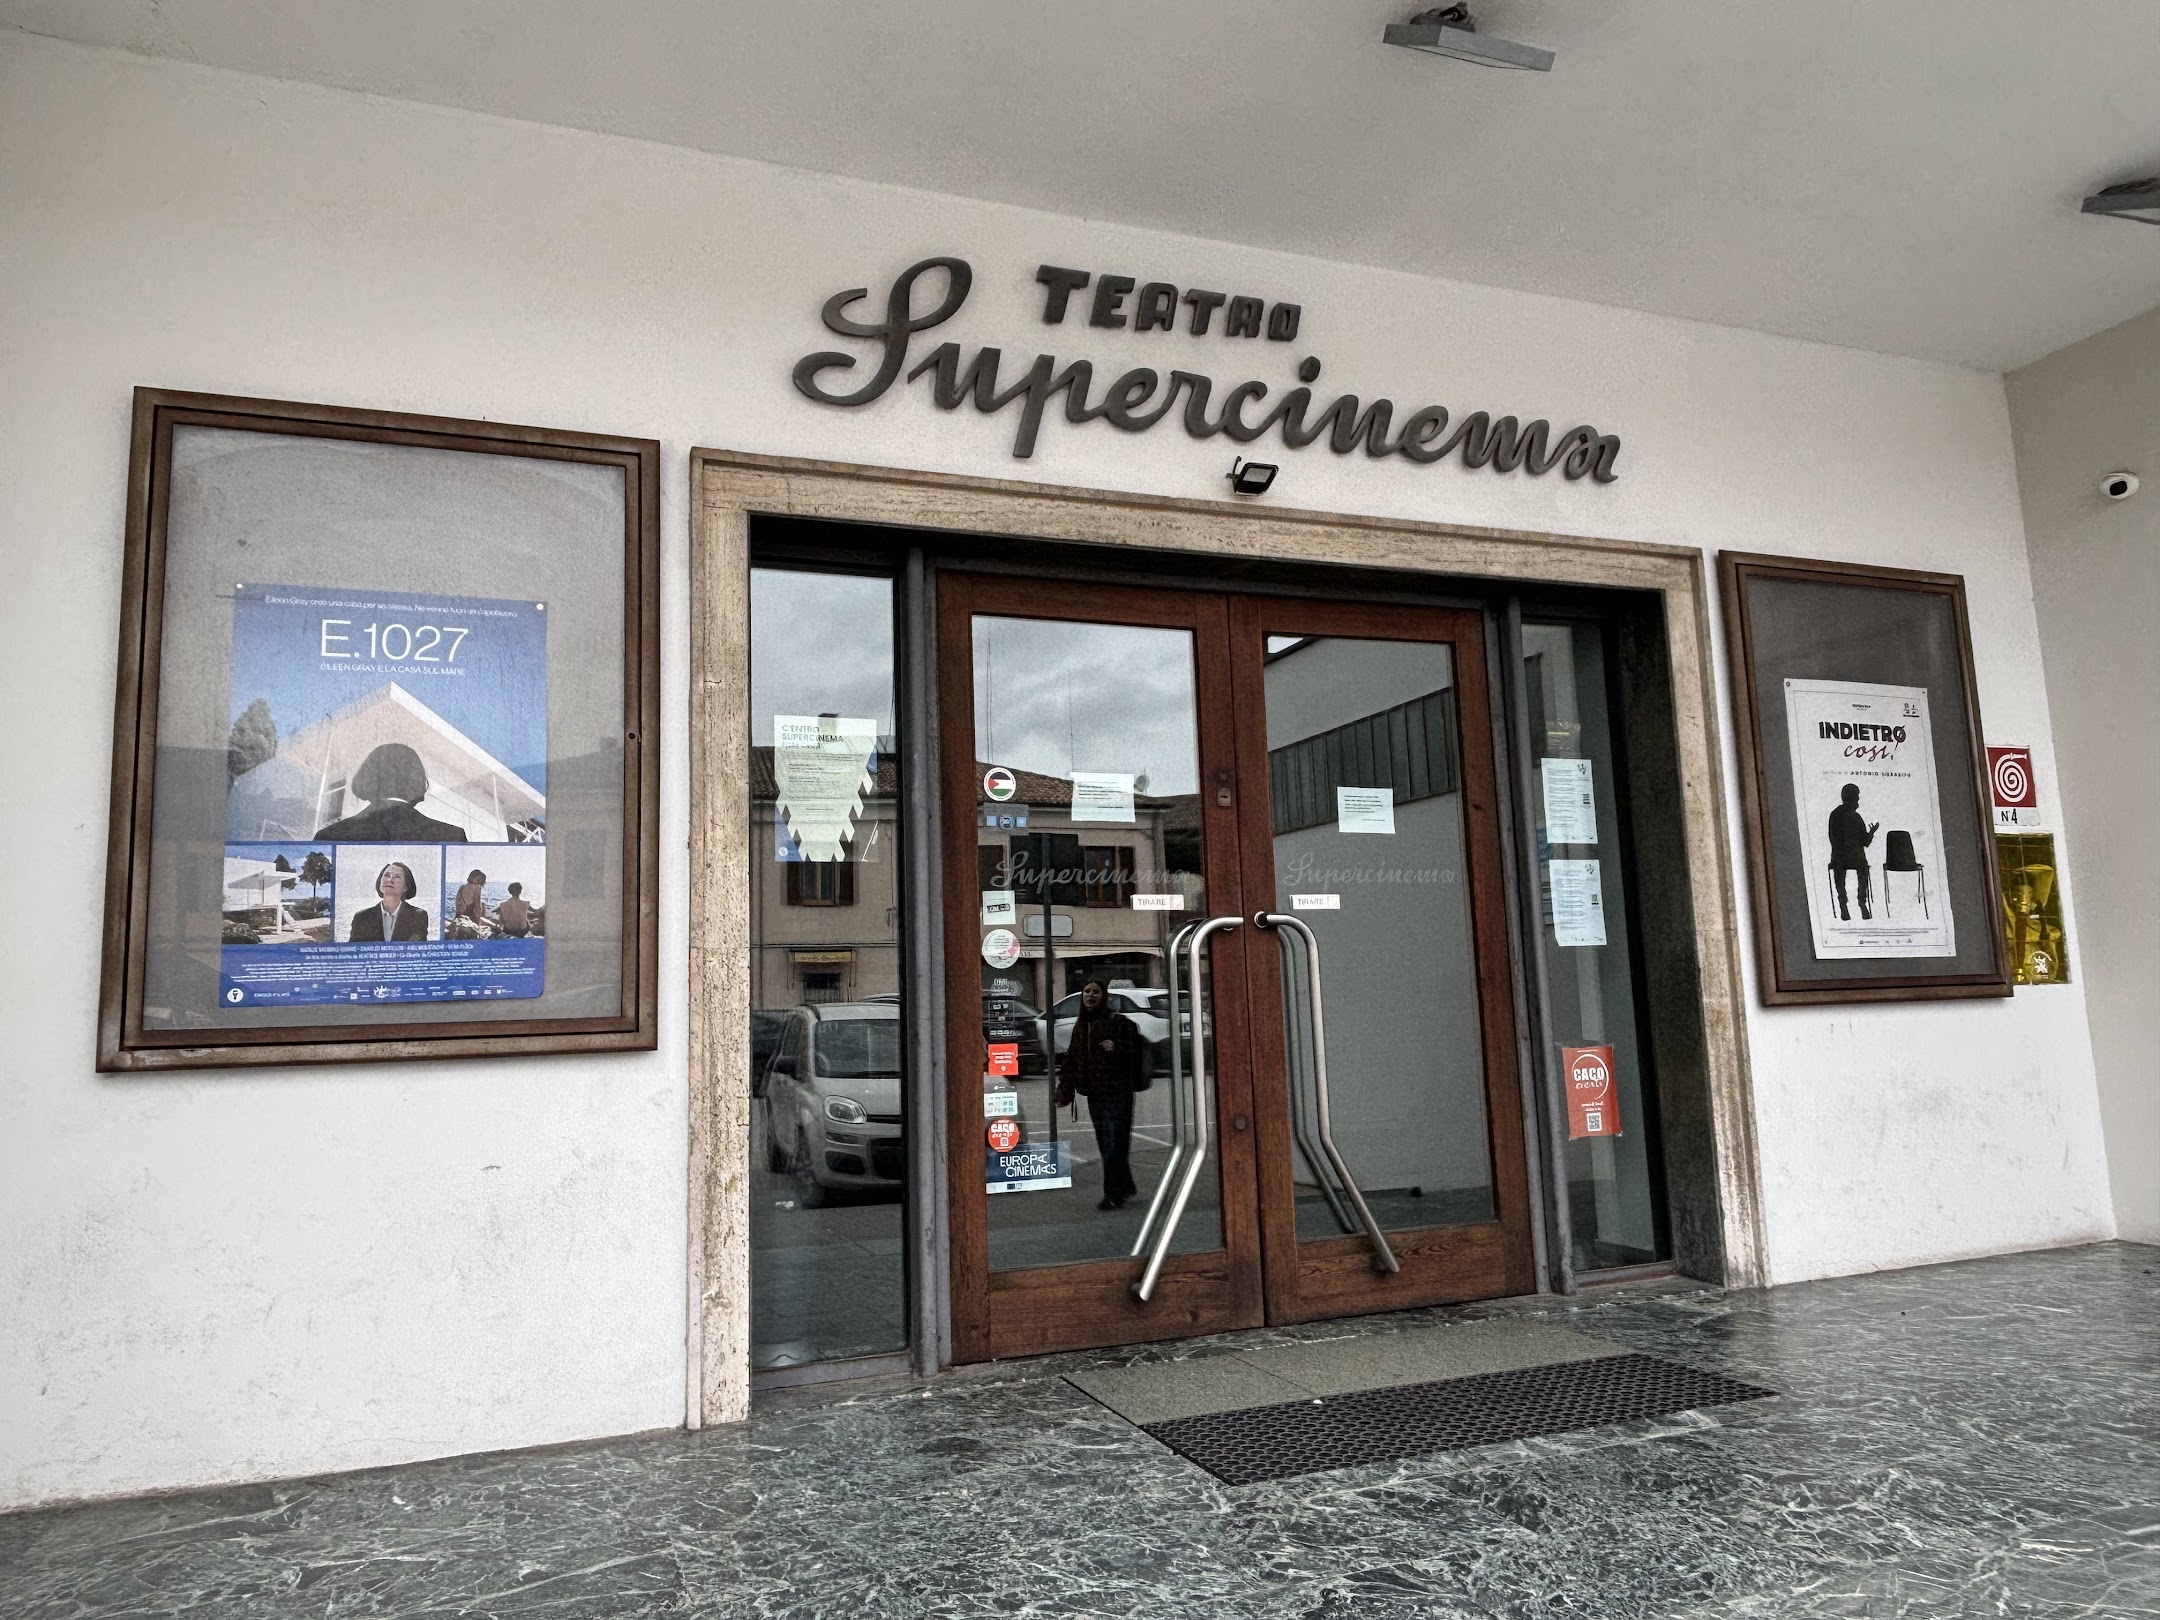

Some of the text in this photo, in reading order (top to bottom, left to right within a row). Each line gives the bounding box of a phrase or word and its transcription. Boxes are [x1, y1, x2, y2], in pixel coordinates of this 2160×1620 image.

[1036, 263, 1302, 342] TEATRO
[792, 255, 1621, 483] Supercinema
[320, 618, 469, 662] E.1027
[351, 663, 376, 672] GRAY
[398, 665, 422, 674] CASA
[782, 724, 820, 733] CENTRO
[1818, 721, 1907, 743] INDIETRO
[990, 850, 1191, 895] Supercinema
[1282, 851, 1456, 891] Supercinema
[1137, 898, 1167, 907] TIRARE
[1297, 898, 1325, 907] TIRARE
[999, 1152, 1048, 1167] EUROPA
[1005, 1163, 1057, 1178] CINEMAS
